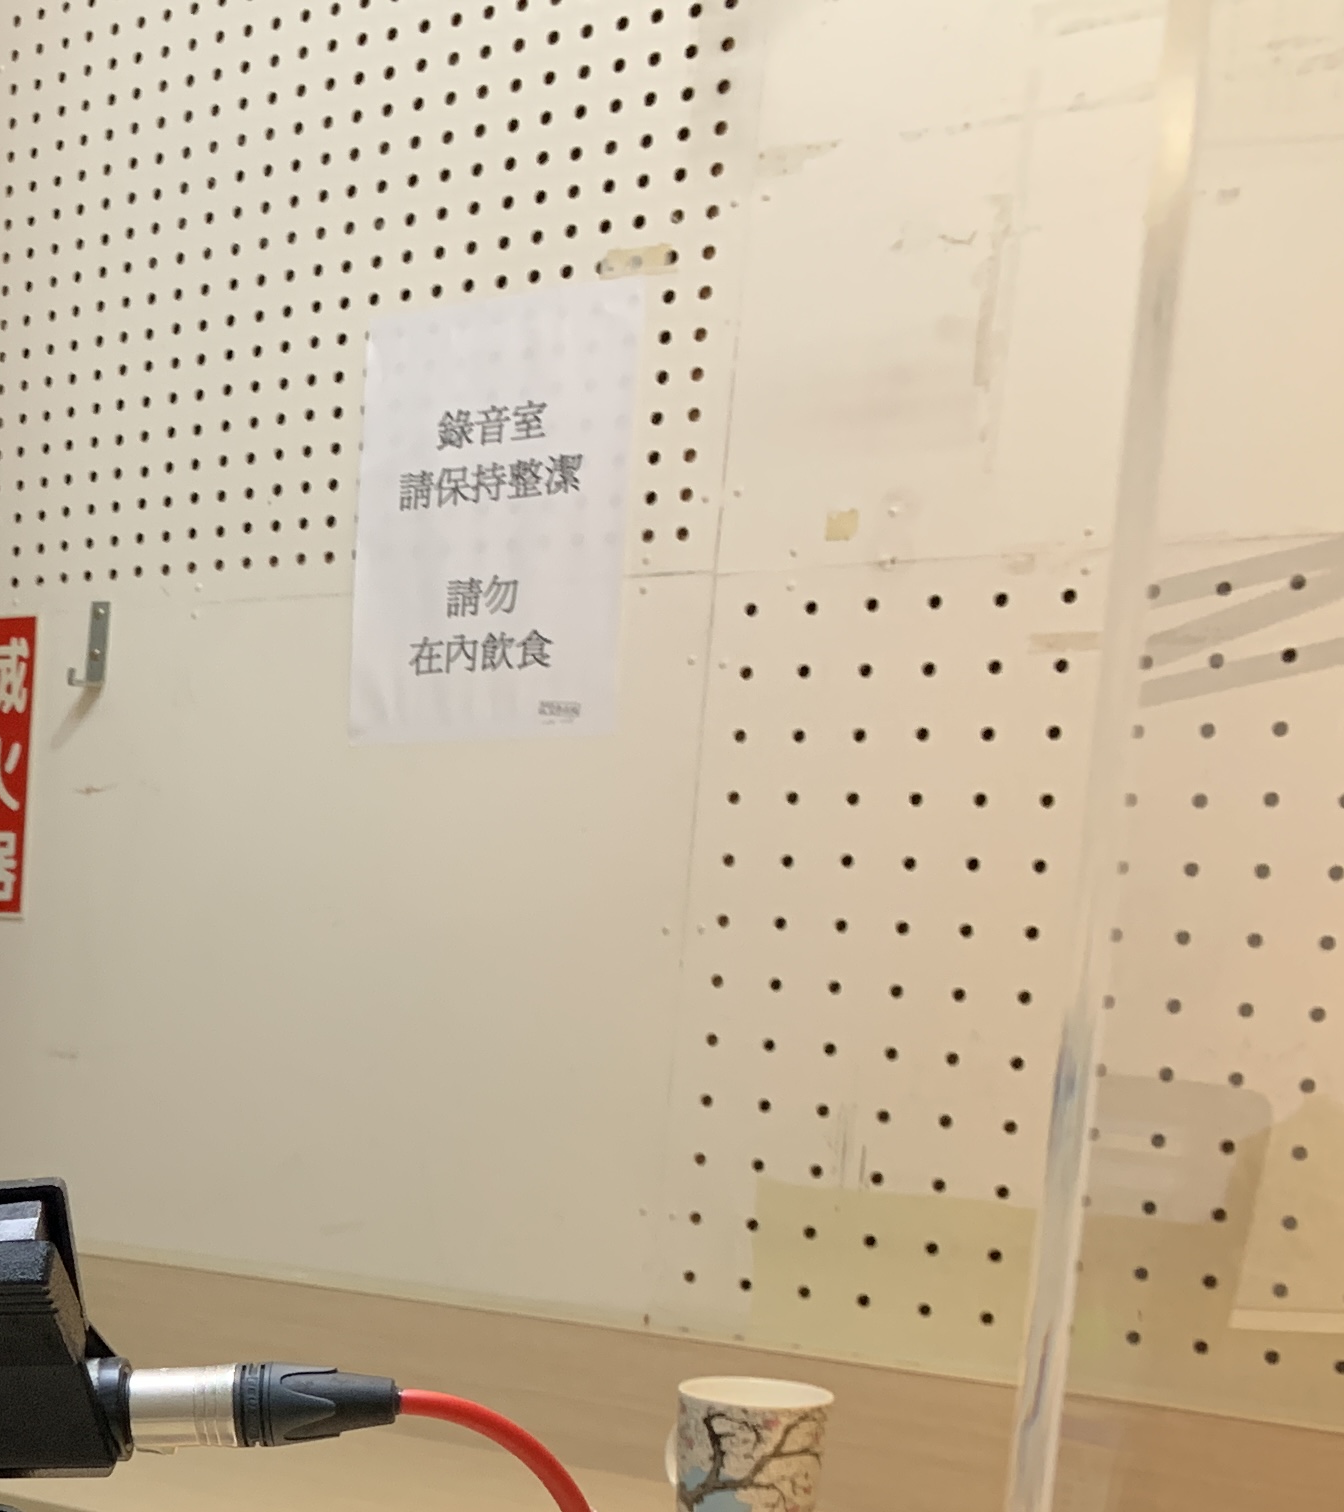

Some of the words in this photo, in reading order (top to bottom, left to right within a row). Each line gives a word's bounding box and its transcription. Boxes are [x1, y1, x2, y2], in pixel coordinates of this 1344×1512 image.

[435, 399, 548, 452] 錄音室
[398, 453, 583, 512] 請保持整潔
[445, 574, 519, 619] 請勿
[409, 628, 554, 677] 在內飲食
